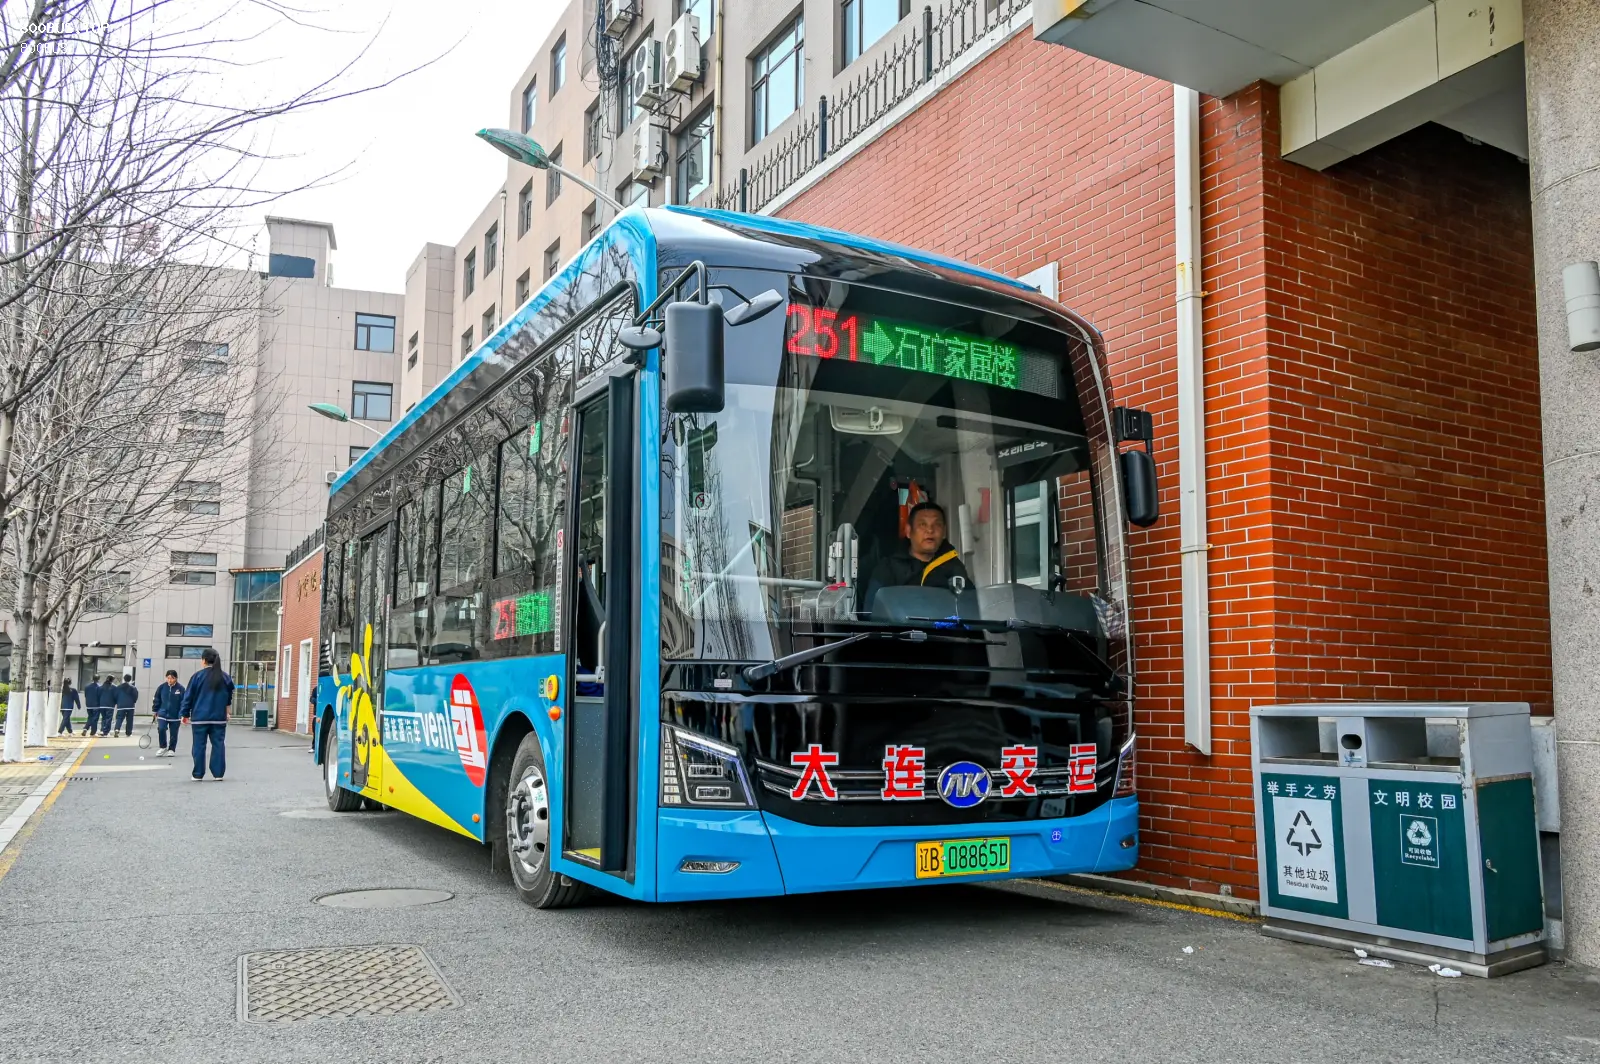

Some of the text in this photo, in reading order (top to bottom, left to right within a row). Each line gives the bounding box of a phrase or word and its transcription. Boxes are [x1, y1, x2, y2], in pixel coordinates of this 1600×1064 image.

[786, 303, 1016, 390] 251 石矿家属楼
[491, 598, 515, 640] 251
[1266, 781, 1337, 800] 举手之劳
[1373, 789, 1457, 810] 文明校园
[1404, 853, 1436, 862] Recyclable
[1283, 865, 1330, 883] 其他垃圾
[1286, 879, 1328, 891] Residual Waste
